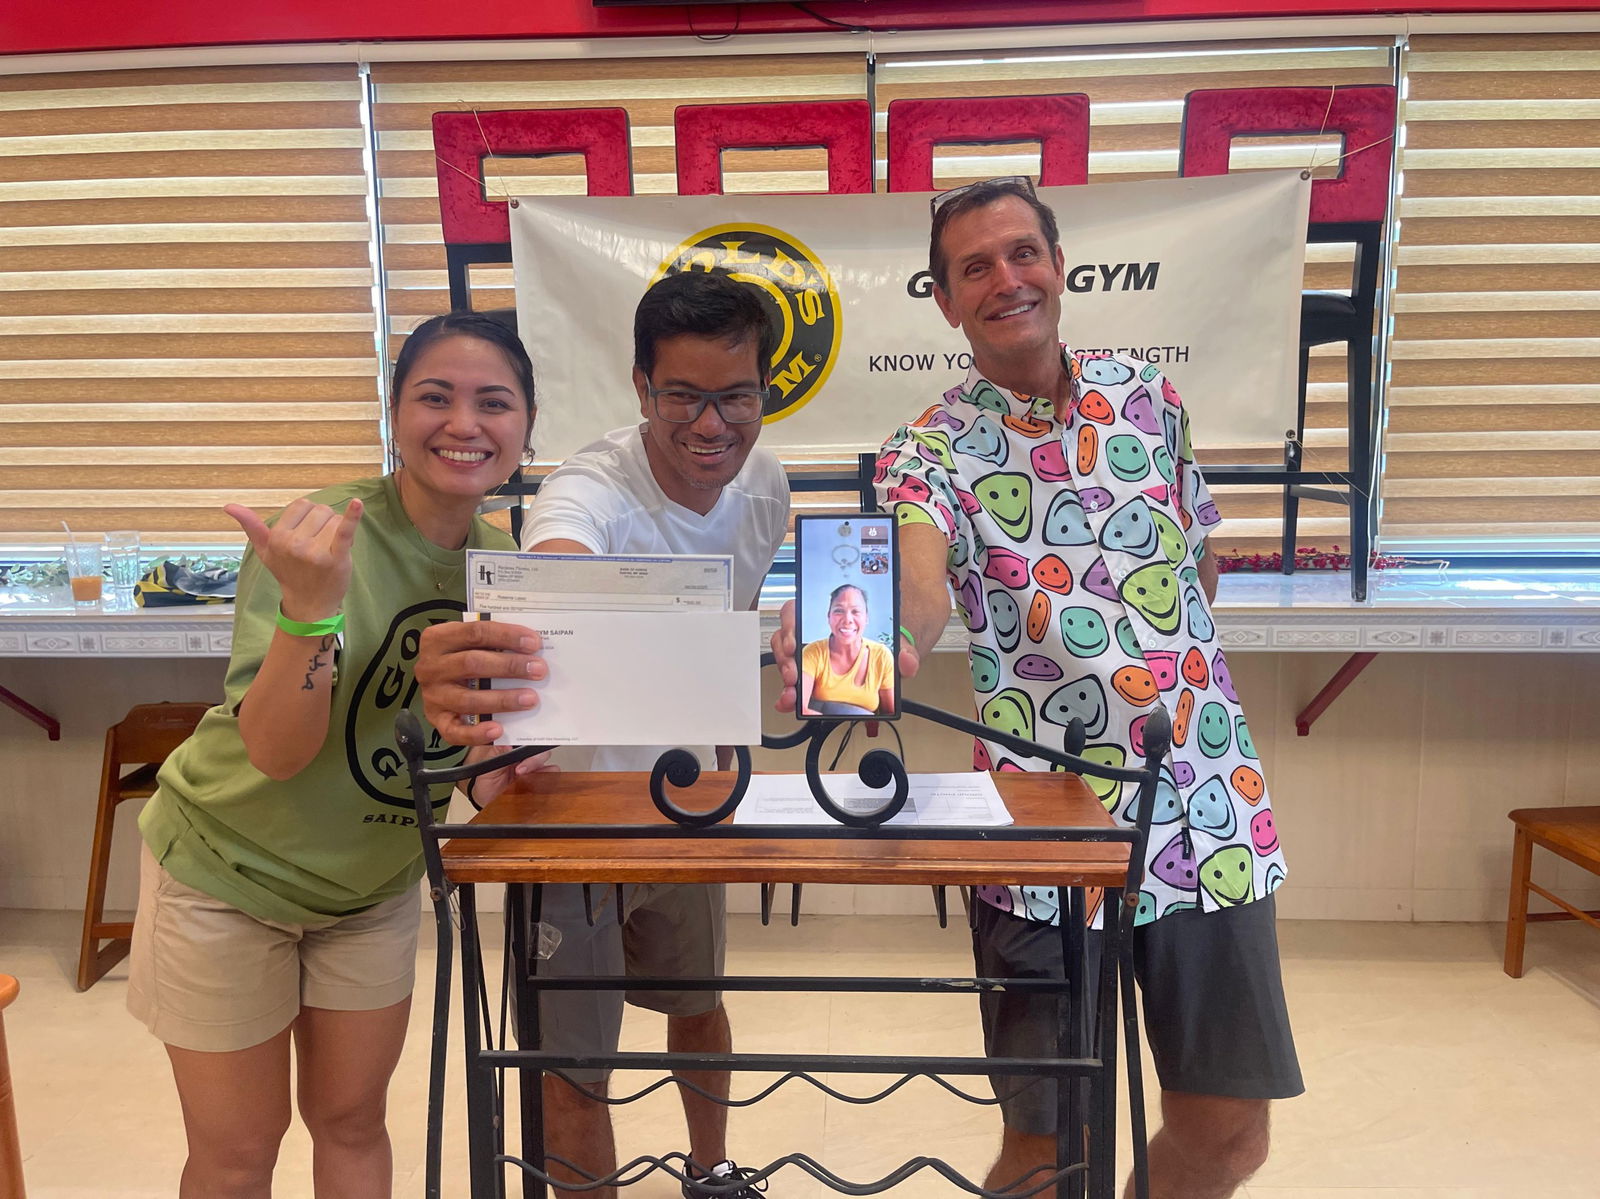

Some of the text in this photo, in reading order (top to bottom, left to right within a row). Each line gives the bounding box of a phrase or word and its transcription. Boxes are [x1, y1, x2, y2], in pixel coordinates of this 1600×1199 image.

[681, 241, 825, 326] OLD'S
[1066, 262, 1160, 293] GYM
[869, 346, 1189, 372] KNOW YO NGTH
[362, 813, 419, 828] SAIP
